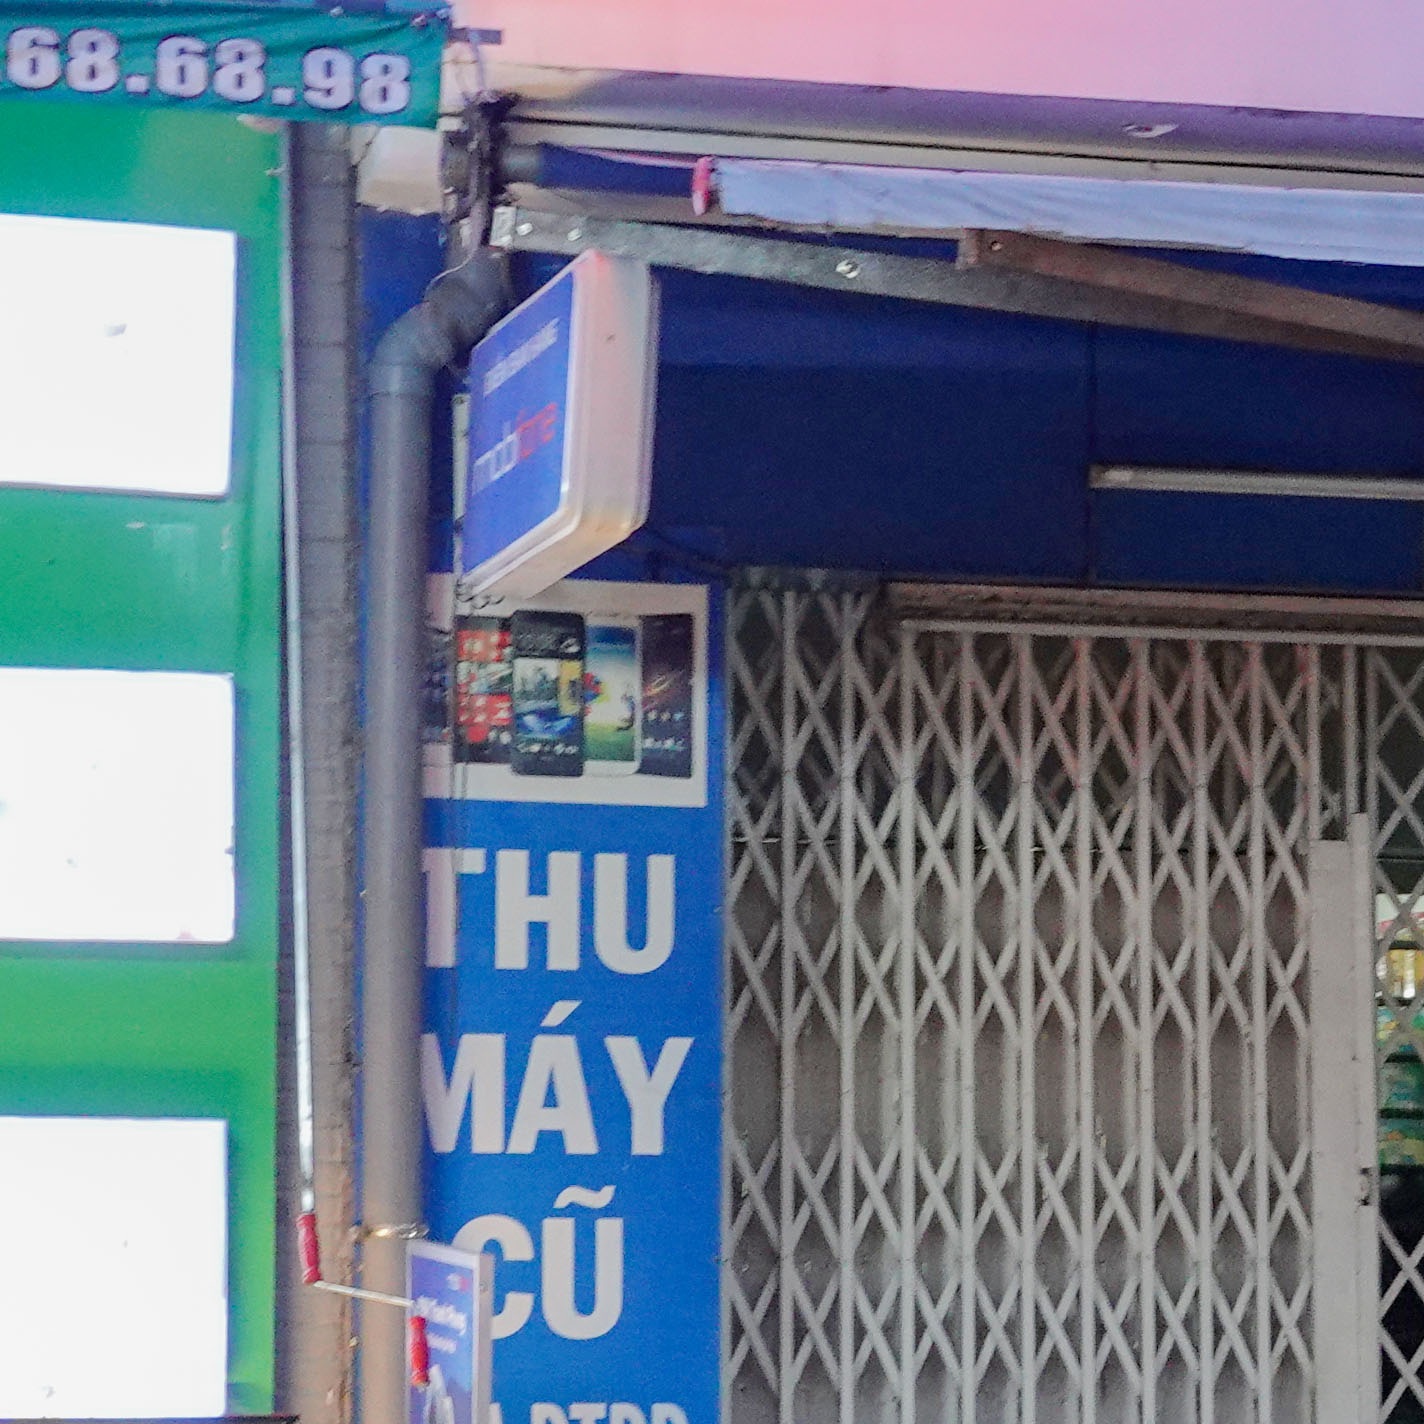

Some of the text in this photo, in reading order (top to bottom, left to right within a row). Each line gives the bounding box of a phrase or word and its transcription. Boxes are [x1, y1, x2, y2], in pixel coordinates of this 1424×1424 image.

[6, 26, 411, 113] 68.68.98
[421, 848, 676, 974] THU
[421, 1002, 694, 1156] MÁY
[451, 1185, 624, 1340] CŨ
